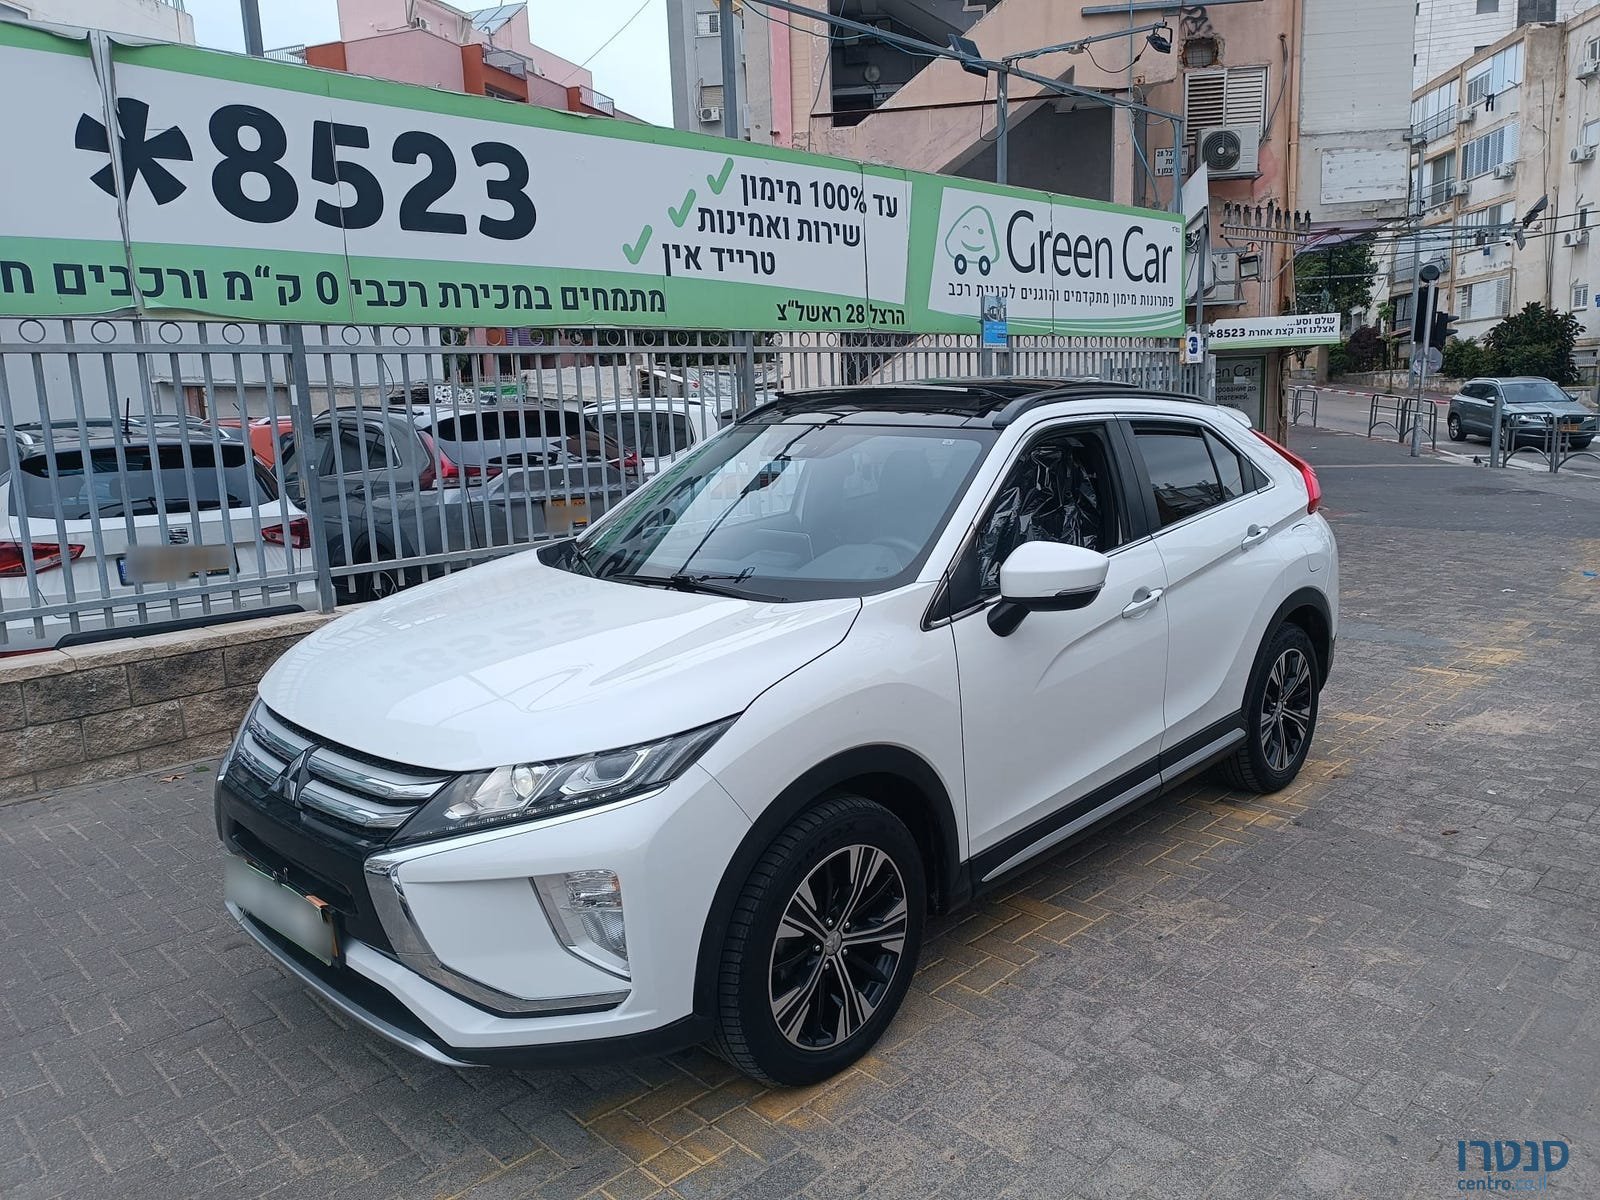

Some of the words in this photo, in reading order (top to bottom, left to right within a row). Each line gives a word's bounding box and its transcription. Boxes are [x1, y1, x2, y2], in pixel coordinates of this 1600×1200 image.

[741, 174, 801, 206] מימון
[810, 181, 867, 214] 100%
[872, 193, 898, 218] עד
[698, 207, 790, 240] ואמינות
[797, 218, 860, 247] שירות
[1006, 209, 1113, 279] Green
[1122, 225, 1173, 284] Car
[662, 243, 702, 276] אין
[710, 246, 775, 275] טרייד
[53, 263, 208, 299] ורכבים
[316, 271, 339, 305] 0
[350, 279, 428, 308] רכבי
[948, 282, 971, 297] רכב
[438, 282, 552, 310] במכירת
[561, 286, 666, 312] מתמחים
[1021, 287, 1059, 301] והוגנים
[1064, 290, 1109, 307] מתקדמים
[1113, 292, 1137, 308] מימון
[1140, 294, 1174, 307] פתרונות
[845, 303, 865, 323] 28
[869, 303, 905, 325] הרצל
[1314, 316, 1335, 325] שלם
[1248, 328, 1273, 336] אחרת
[1275, 327, 1294, 336] קצת
[1309, 325, 1335, 334] אצלנו
[1233, 364, 1257, 377] Car
